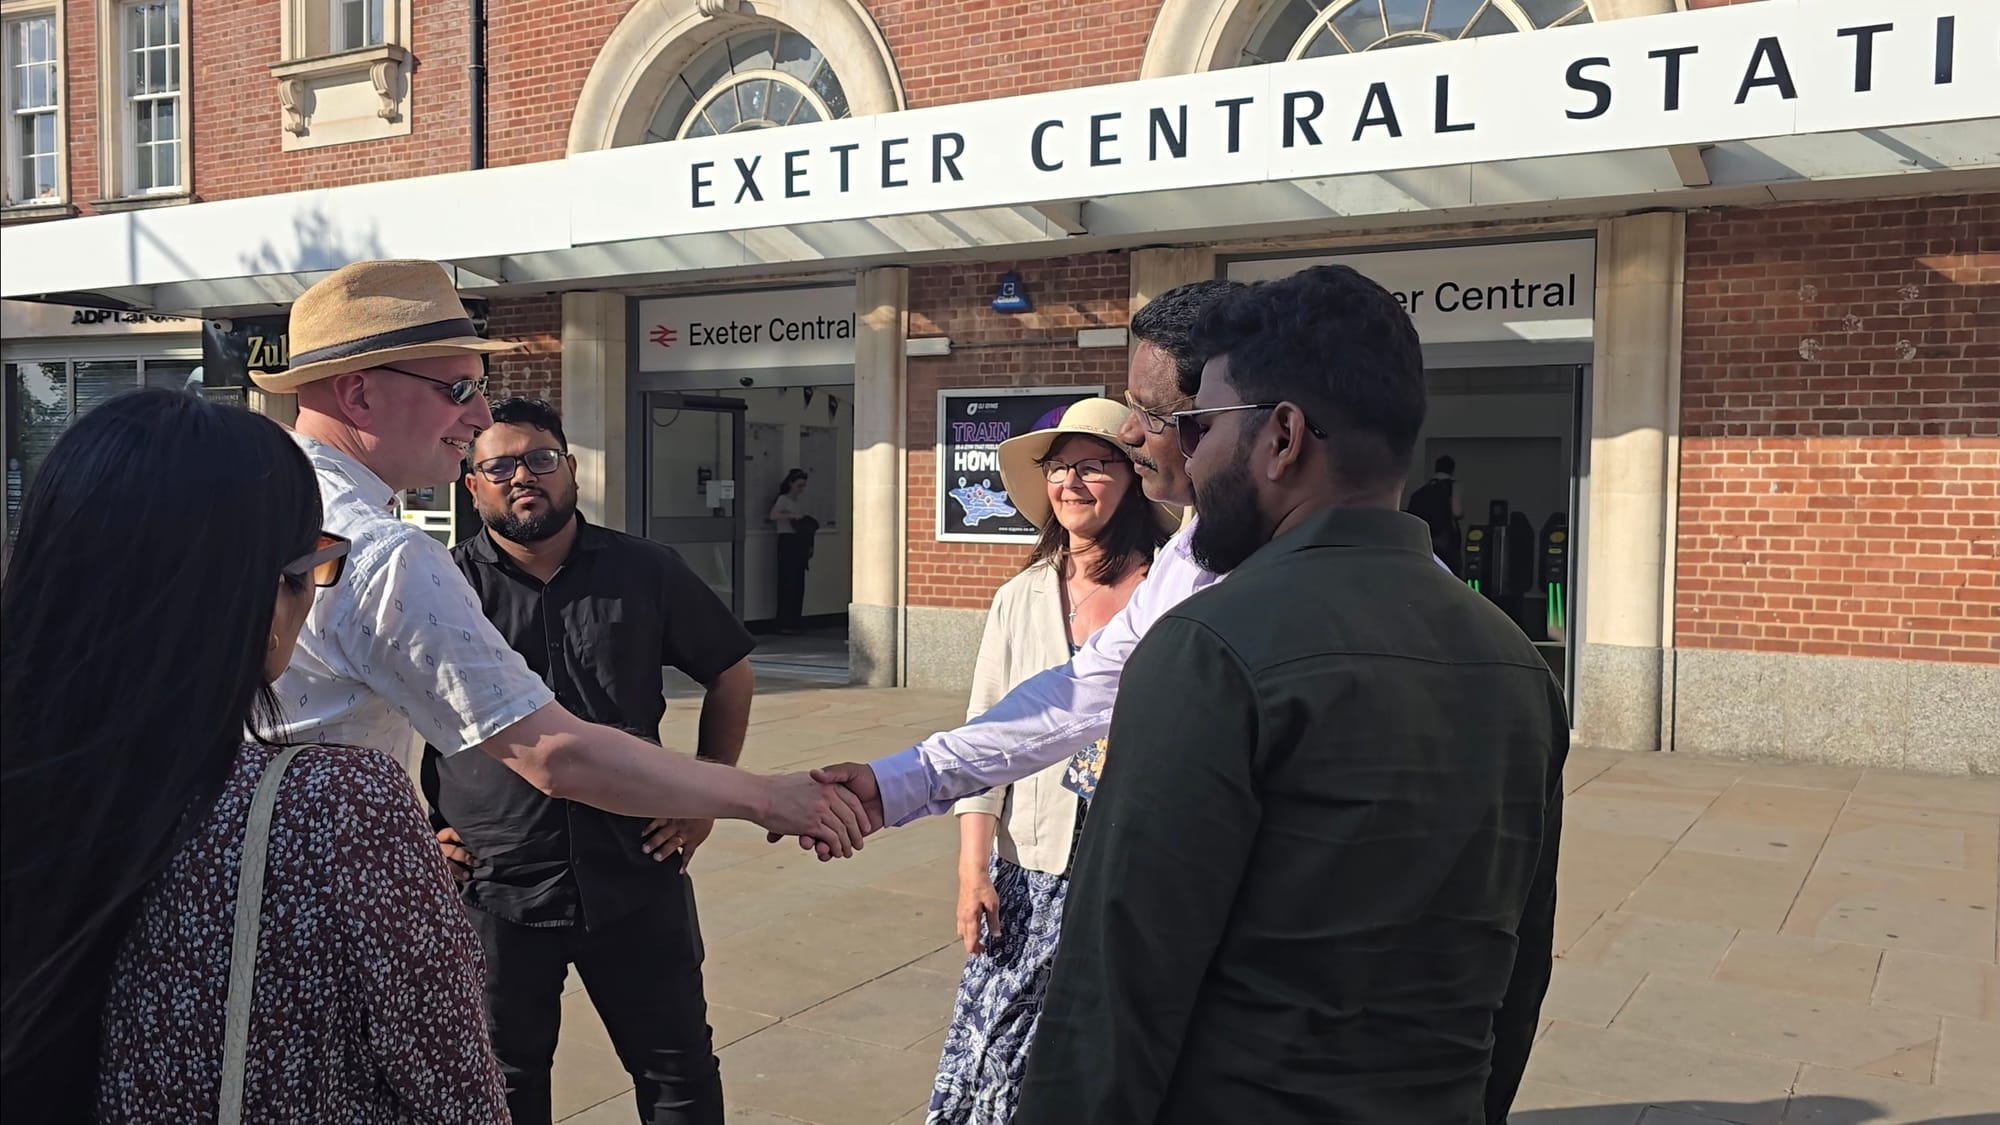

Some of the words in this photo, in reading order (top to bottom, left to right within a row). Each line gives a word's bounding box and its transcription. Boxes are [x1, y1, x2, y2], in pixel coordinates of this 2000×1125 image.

[690, 131, 966, 210] EXETER
[1029, 74, 1476, 173] CENTRAL
[1564, 14, 1956, 121] STATI
[1434, 273, 1576, 313] Central
[689, 320, 763, 347] Exeter
[768, 311, 856, 343] Central
[953, 422, 1010, 441] TRAIN
